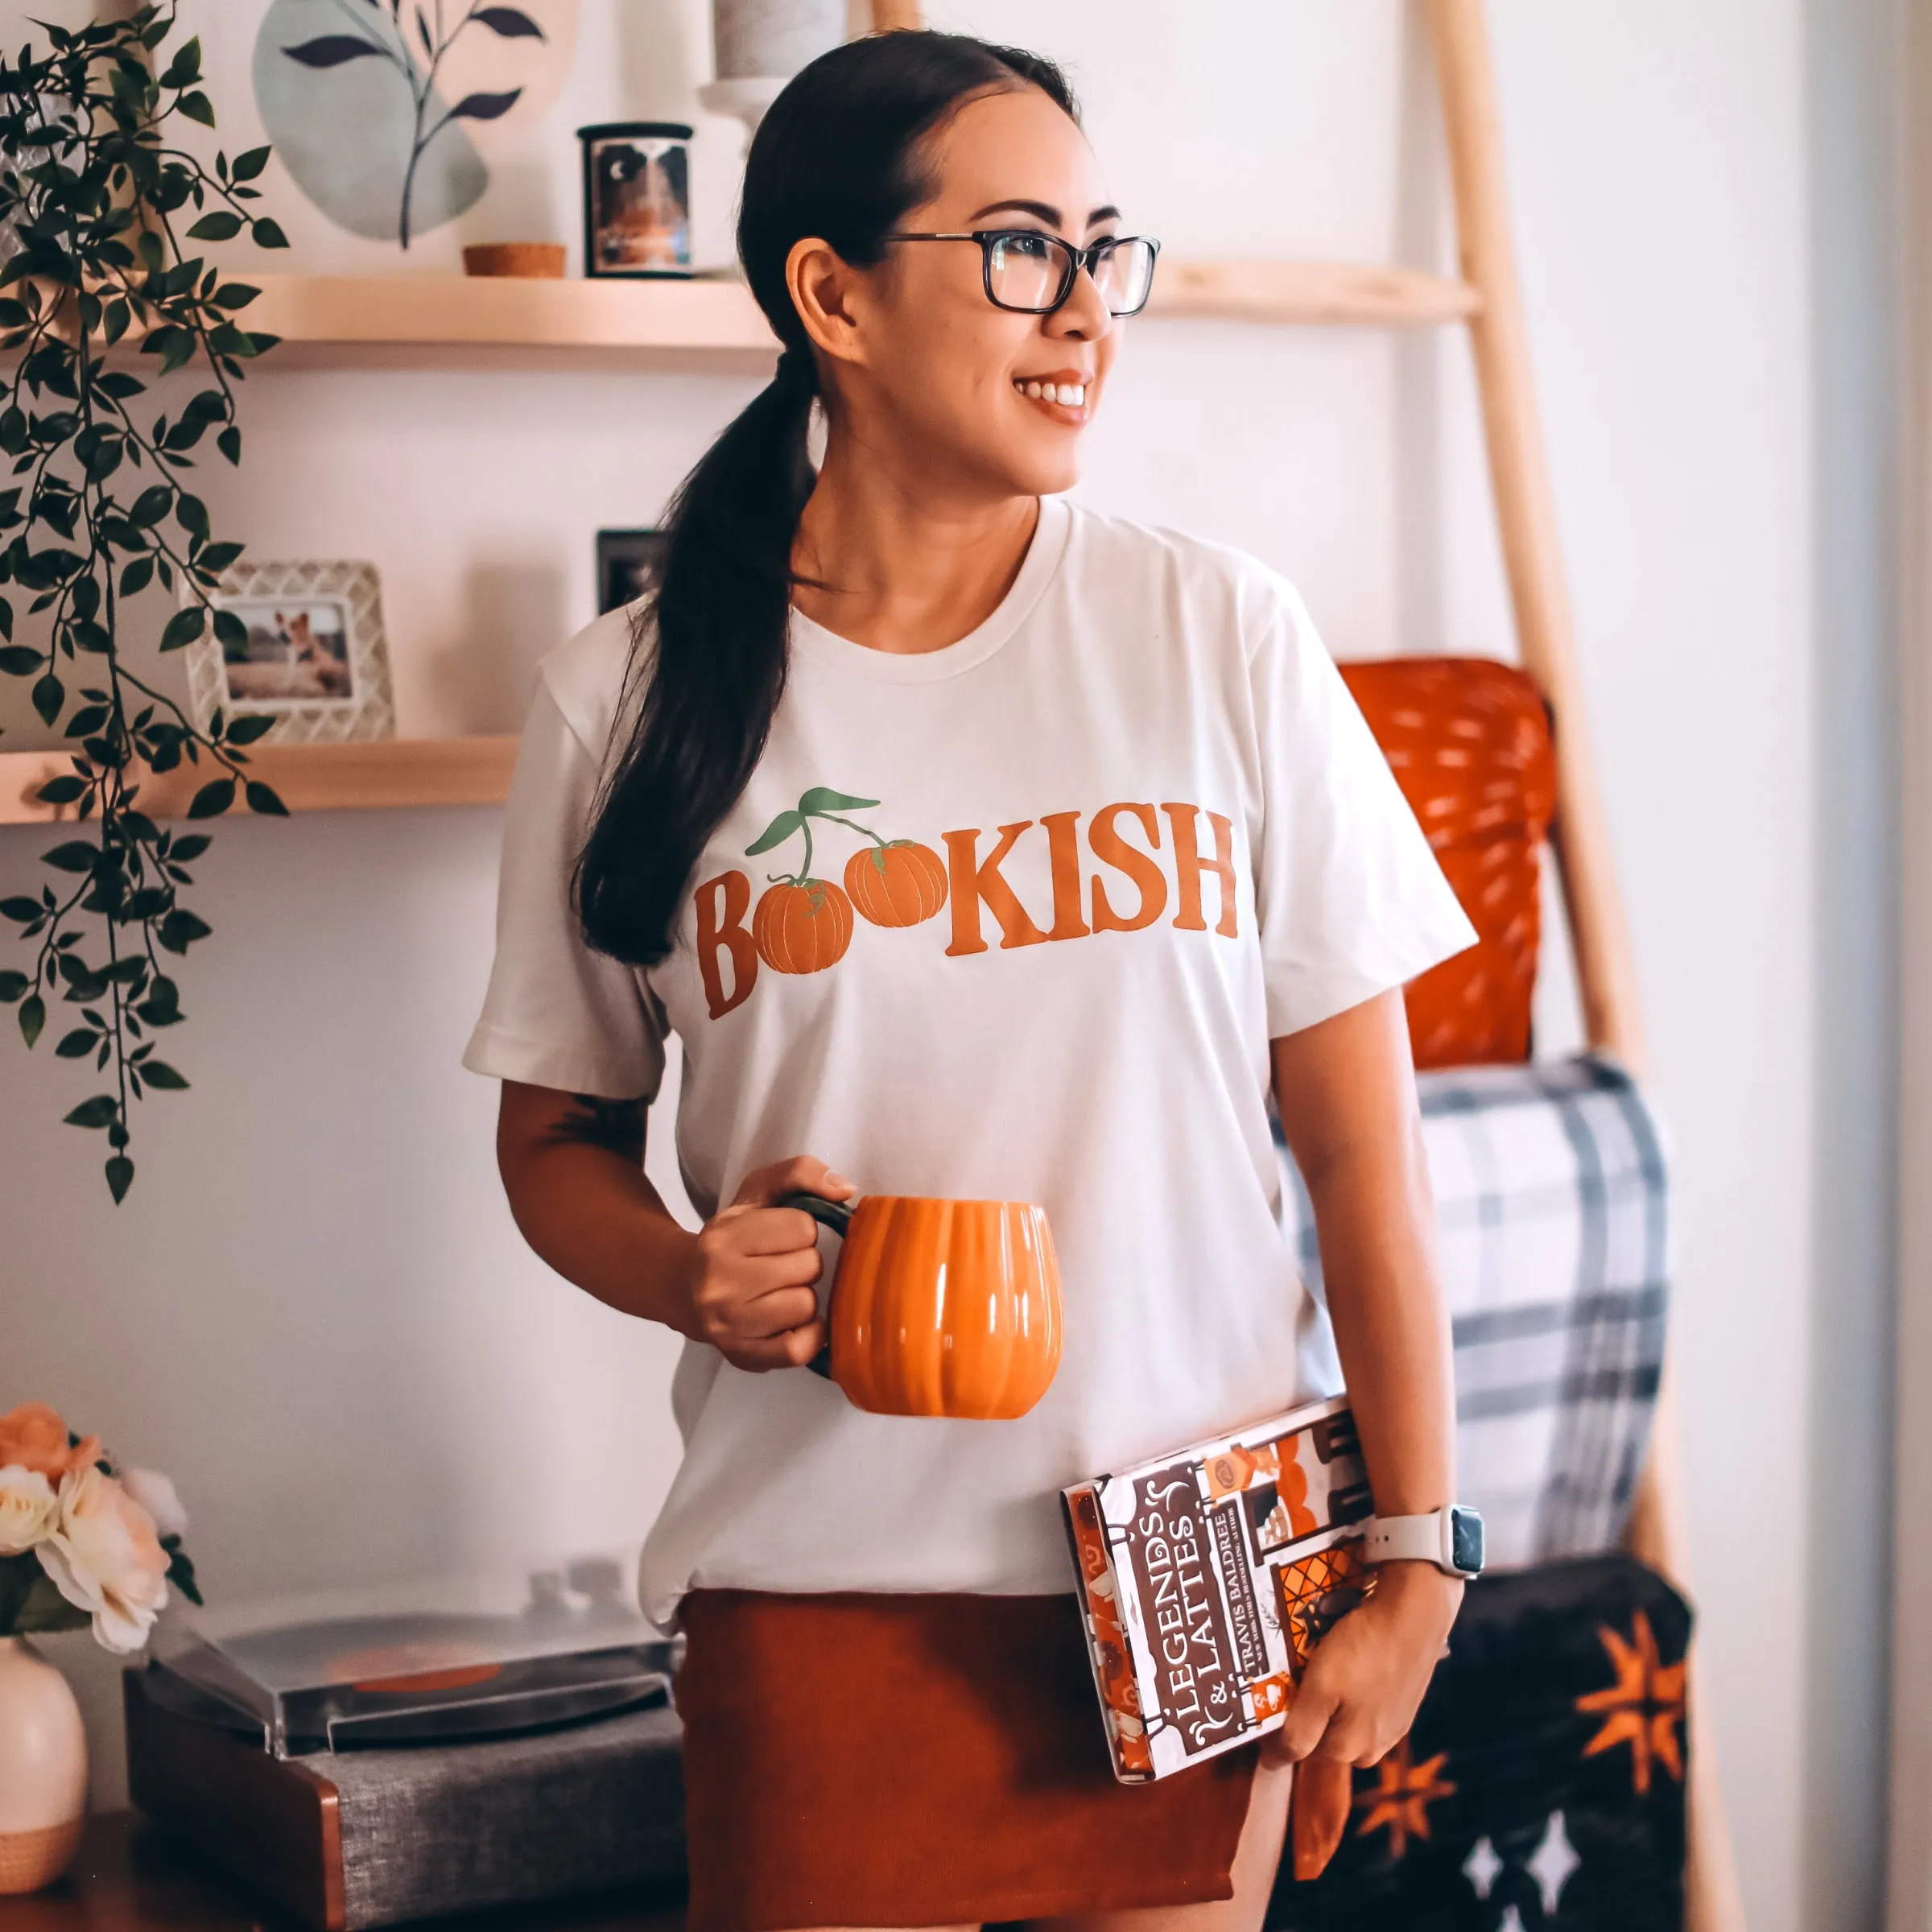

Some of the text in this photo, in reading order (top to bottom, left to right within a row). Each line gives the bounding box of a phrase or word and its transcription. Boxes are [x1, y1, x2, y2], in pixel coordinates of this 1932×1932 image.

[695, 803, 1237, 1021] BOOKISH
[1139, 1512, 1201, 1719] LEGENDS
[1169, 1515, 1228, 1705] & LATTES
[1215, 1513, 1256, 1673] TRAVIS BALDREE
[1255, 1643, 1263, 1662] NEW
